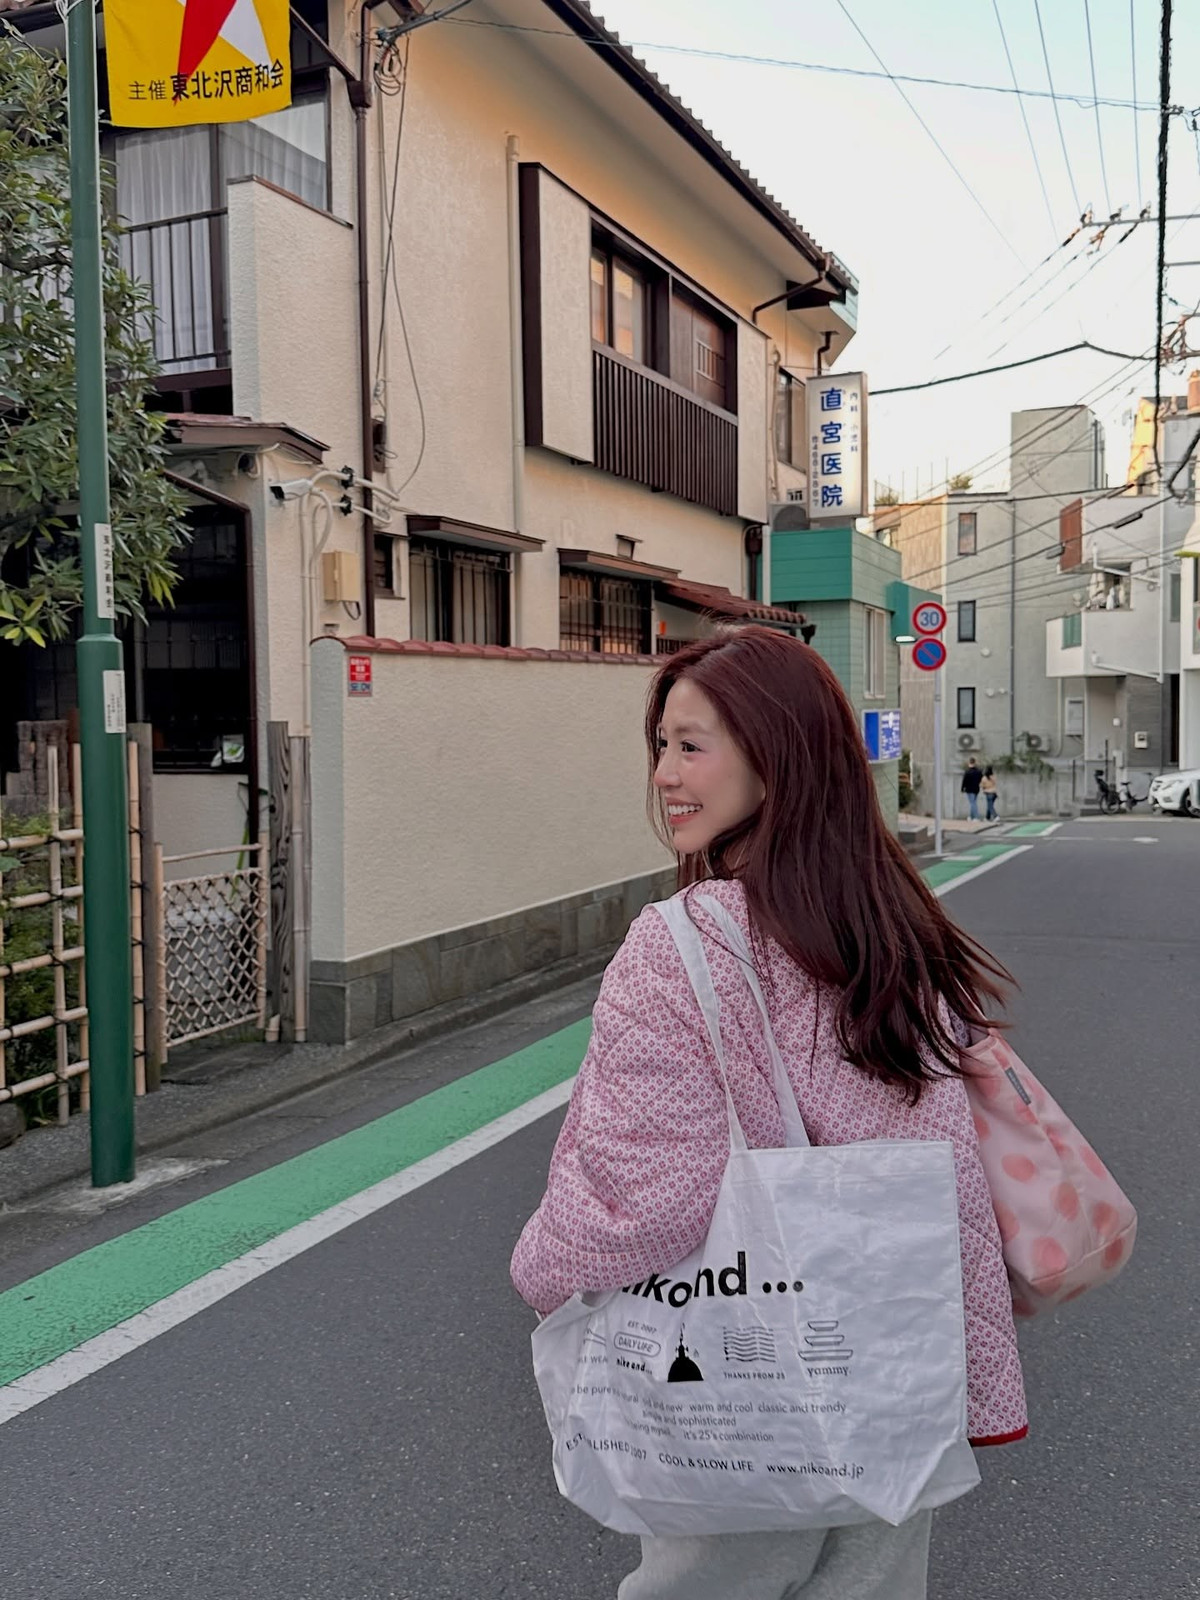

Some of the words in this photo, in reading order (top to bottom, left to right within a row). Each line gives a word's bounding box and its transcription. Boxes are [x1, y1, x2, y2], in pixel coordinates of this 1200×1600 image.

[128, 80, 167, 100] 主催
[170, 58, 284, 101] 東北沢商和会
[820, 387, 843, 507] 直宮医院
[920, 611, 940, 627] 30
[723, 1372, 751, 1380] THANKS
[752, 1372, 774, 1380] FROM
[689, 1402, 714, 1412] warm
[717, 1401, 732, 1413] and
[734, 1401, 754, 1413] cool
[758, 1401, 788, 1414] classic
[789, 1402, 809, 1414] and
[811, 1400, 847, 1415] trendy
[678, 1414, 737, 1428] sophisticated
[719, 1431, 775, 1443] combination
[658, 1452, 687, 1468] COOL
[688, 1458, 695, 1468] &
[696, 1457, 730, 1472] SLOW
[732, 1460, 756, 1473] LIFE
[766, 1462, 865, 1480] www.nikoand.jp
